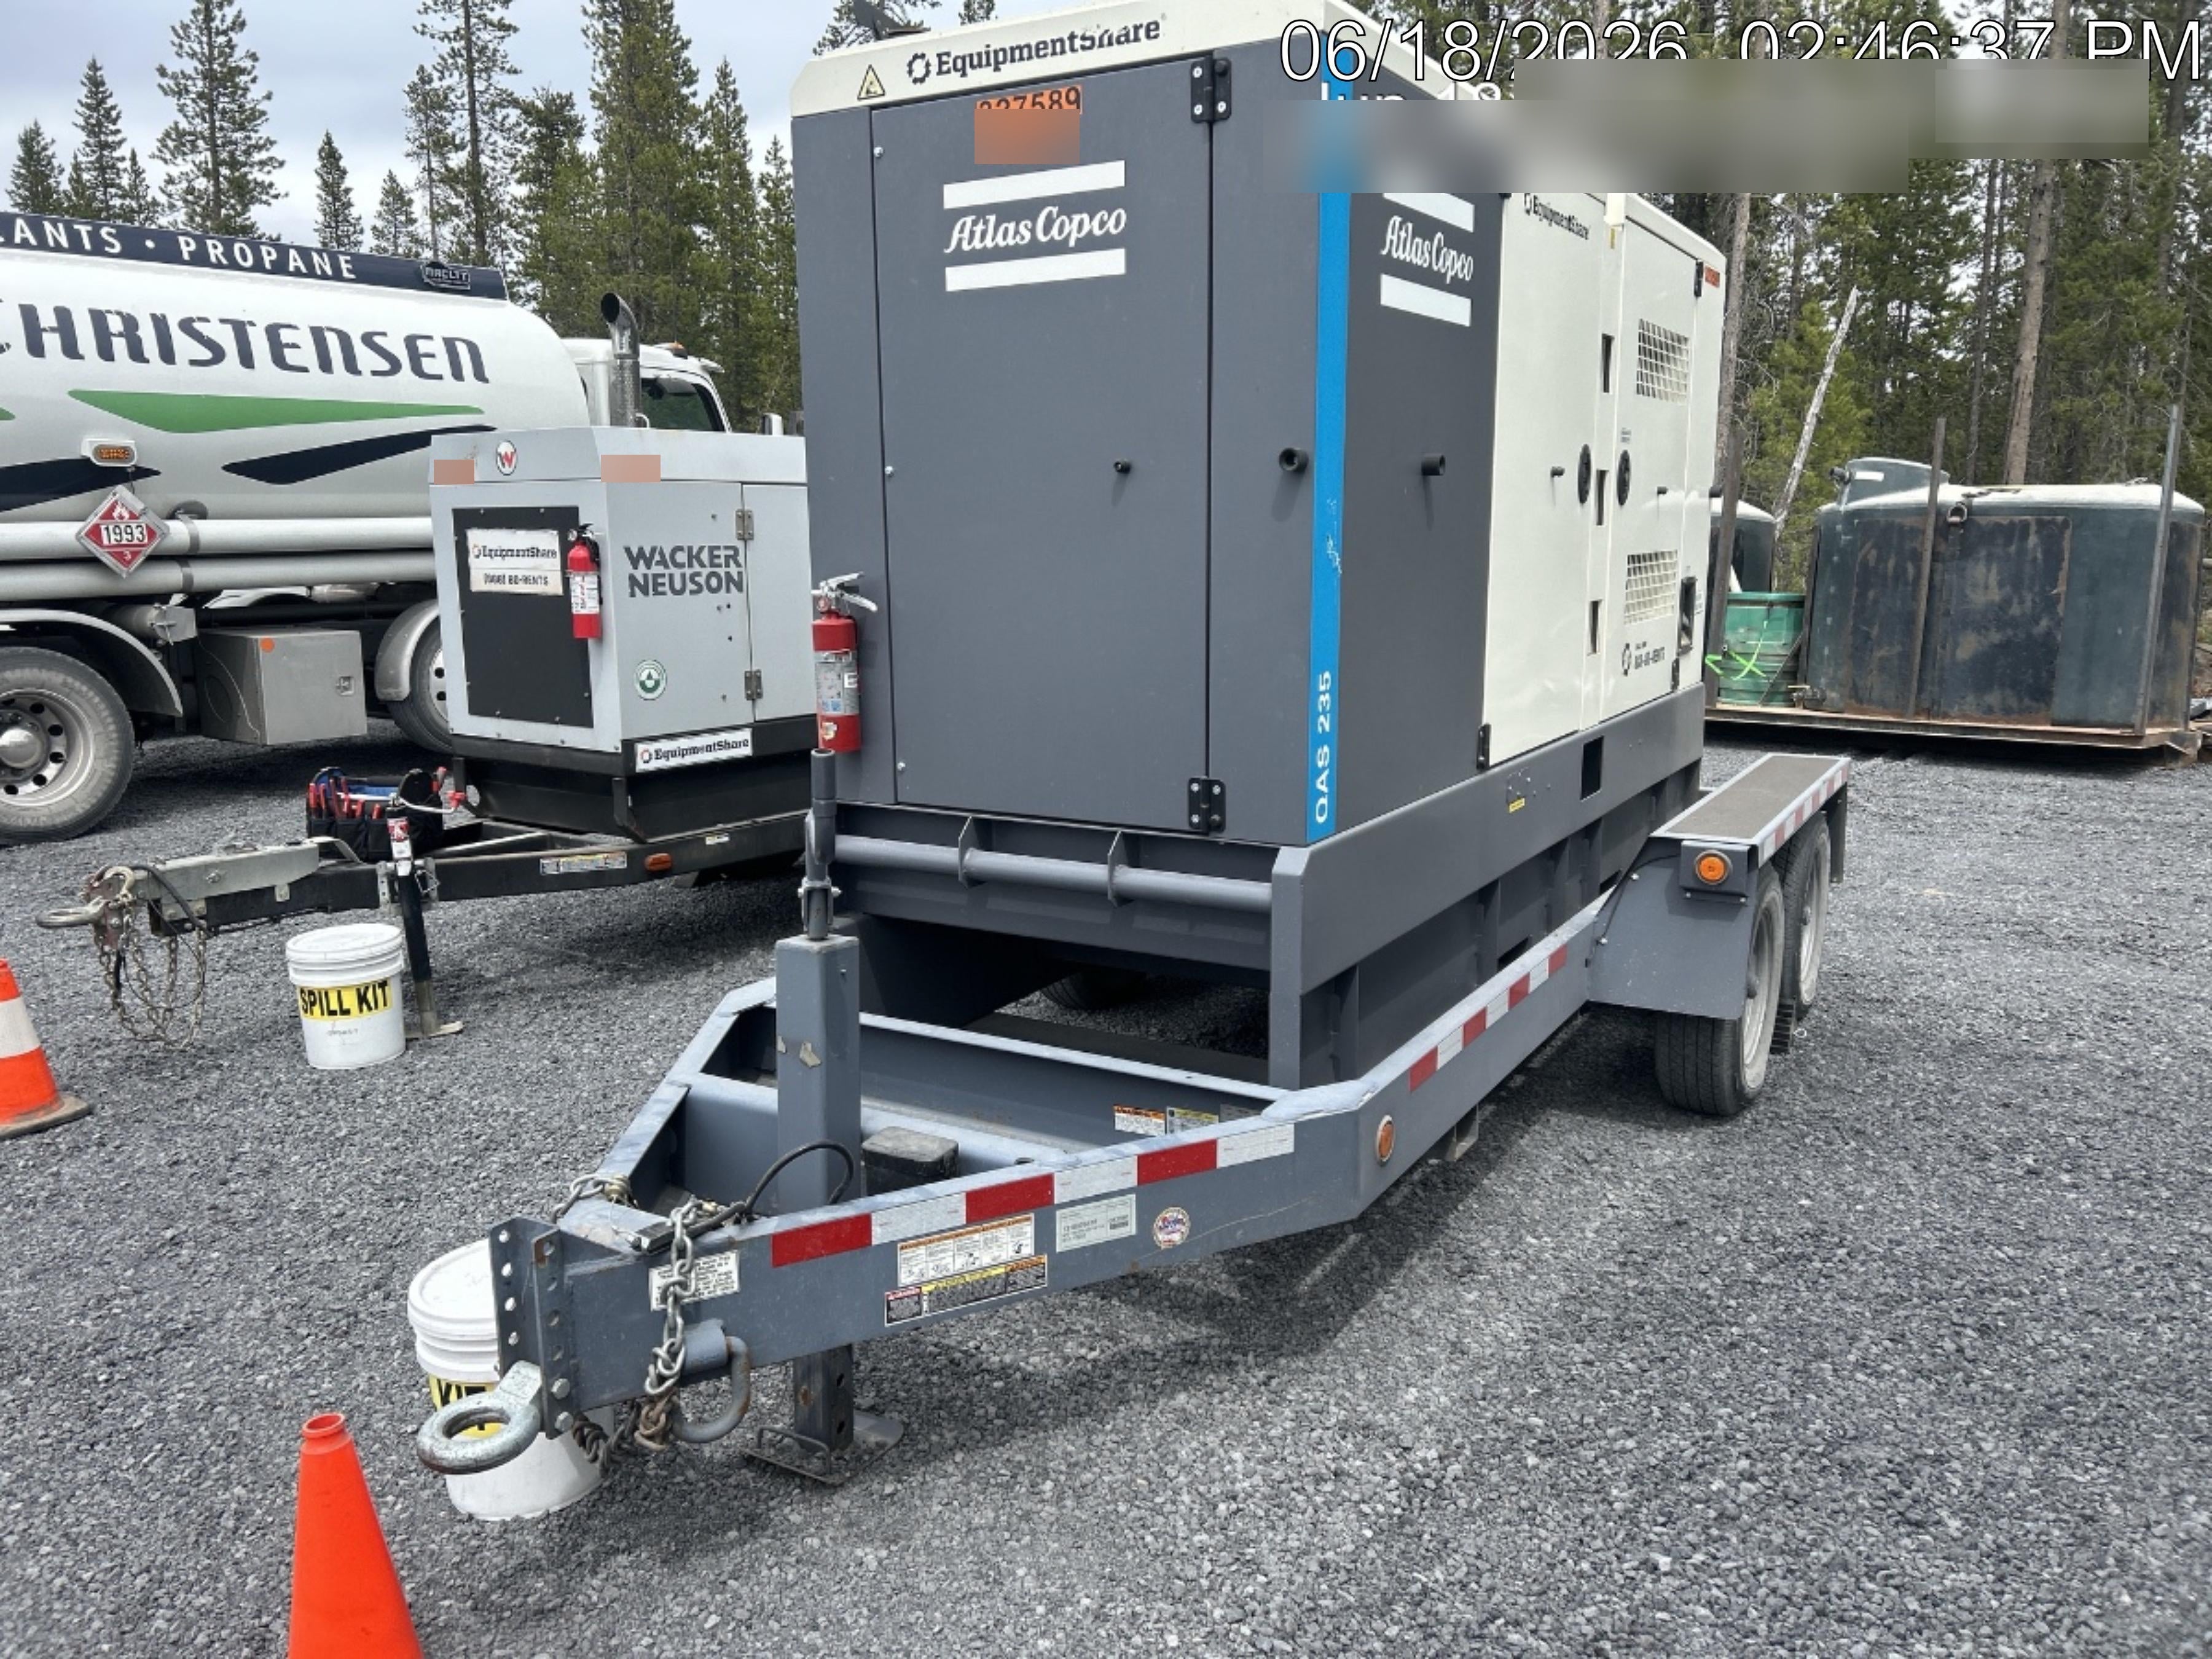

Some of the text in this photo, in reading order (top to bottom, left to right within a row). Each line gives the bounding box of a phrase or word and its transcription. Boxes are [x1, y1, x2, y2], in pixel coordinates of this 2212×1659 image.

[936, 20, 1161, 78] EquipmentShare
[0, 218, 356, 280] ANTS PROPANE
[943, 205, 1127, 253] Atlas Copco
[1379, 215, 1474, 284] Atlas Copco
[0, 298, 490, 384] HRISTENSEN
[104, 525, 145, 544] 1993
[623, 545, 743, 570] WACKER
[628, 571, 744, 598] NEUSON
[1315, 670, 1332, 824] QAS 235
[300, 980, 388, 1016] SPILL KIT
